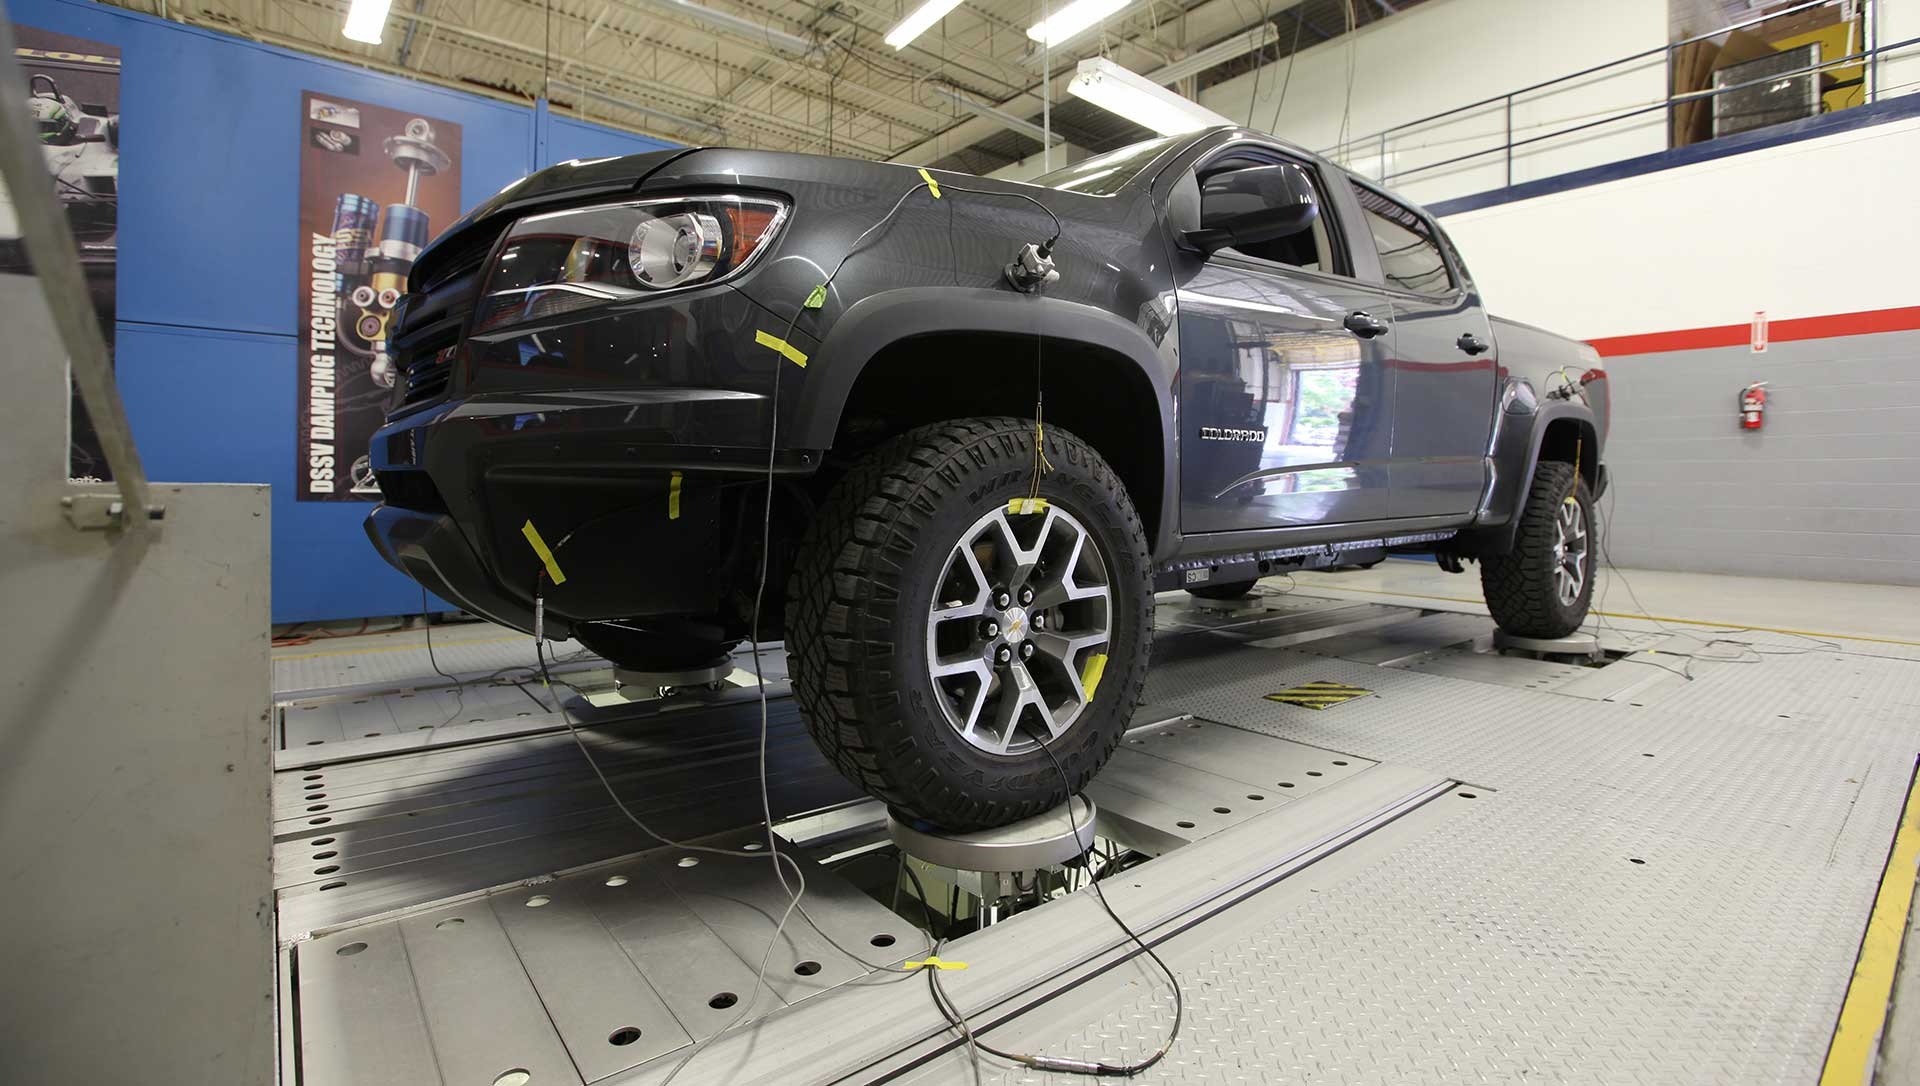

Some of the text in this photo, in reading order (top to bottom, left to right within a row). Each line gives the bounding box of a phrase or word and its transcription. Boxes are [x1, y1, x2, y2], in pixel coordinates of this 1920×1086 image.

[309, 232, 337, 494] DSSV DAMPING TECHNOLOGY
